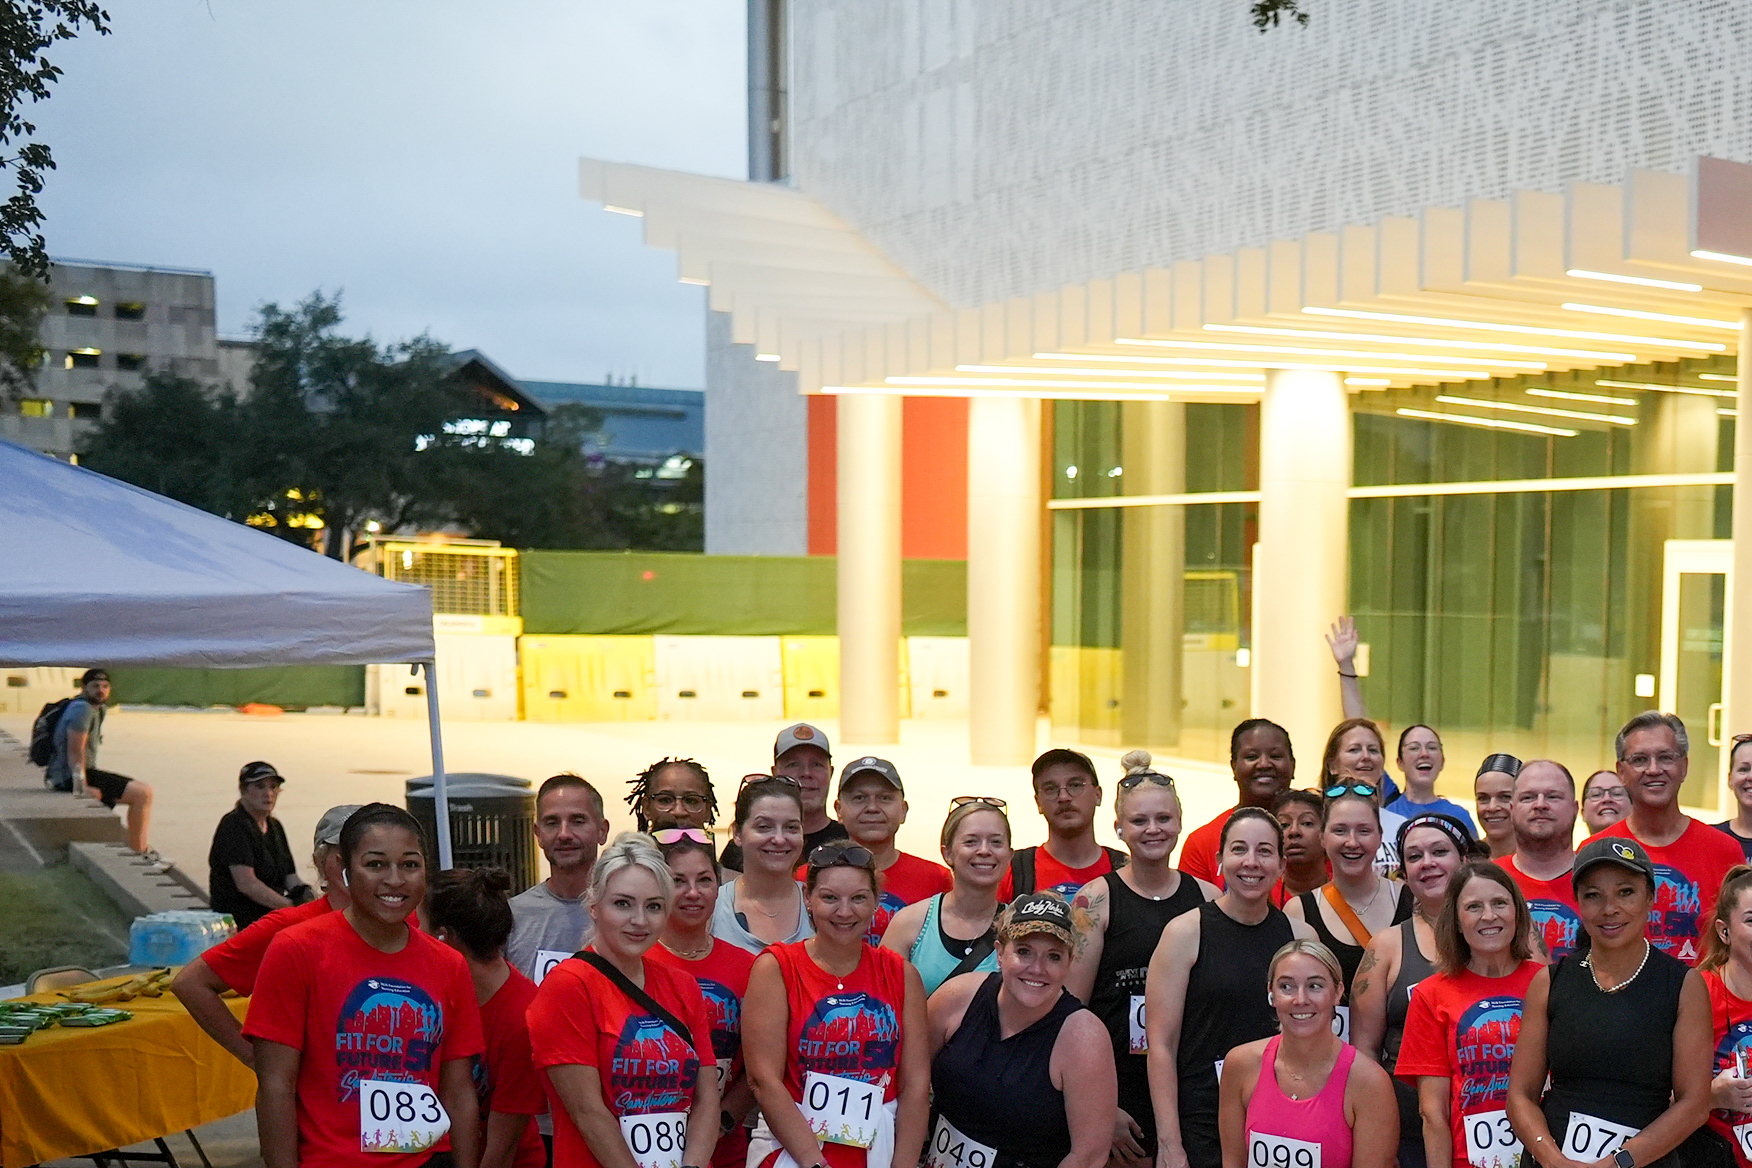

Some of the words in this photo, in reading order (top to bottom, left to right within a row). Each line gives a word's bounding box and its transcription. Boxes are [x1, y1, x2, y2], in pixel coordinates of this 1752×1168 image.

[336, 1033, 363, 1050] FIT
[366, 1034, 403, 1054] FOR
[798, 1038, 822, 1057] FIT
[824, 1040, 861, 1056] FOR
[1457, 1045, 1478, 1064] FIT
[612, 1057, 639, 1074] FIT
[646, 1057, 680, 1076] FOR
[612, 1075, 678, 1090] FUTURE
[370, 1089, 442, 1124] 083
[809, 1081, 873, 1120] 011
[630, 1120, 687, 1155] 088
[1473, 1117, 1517, 1150] 03
